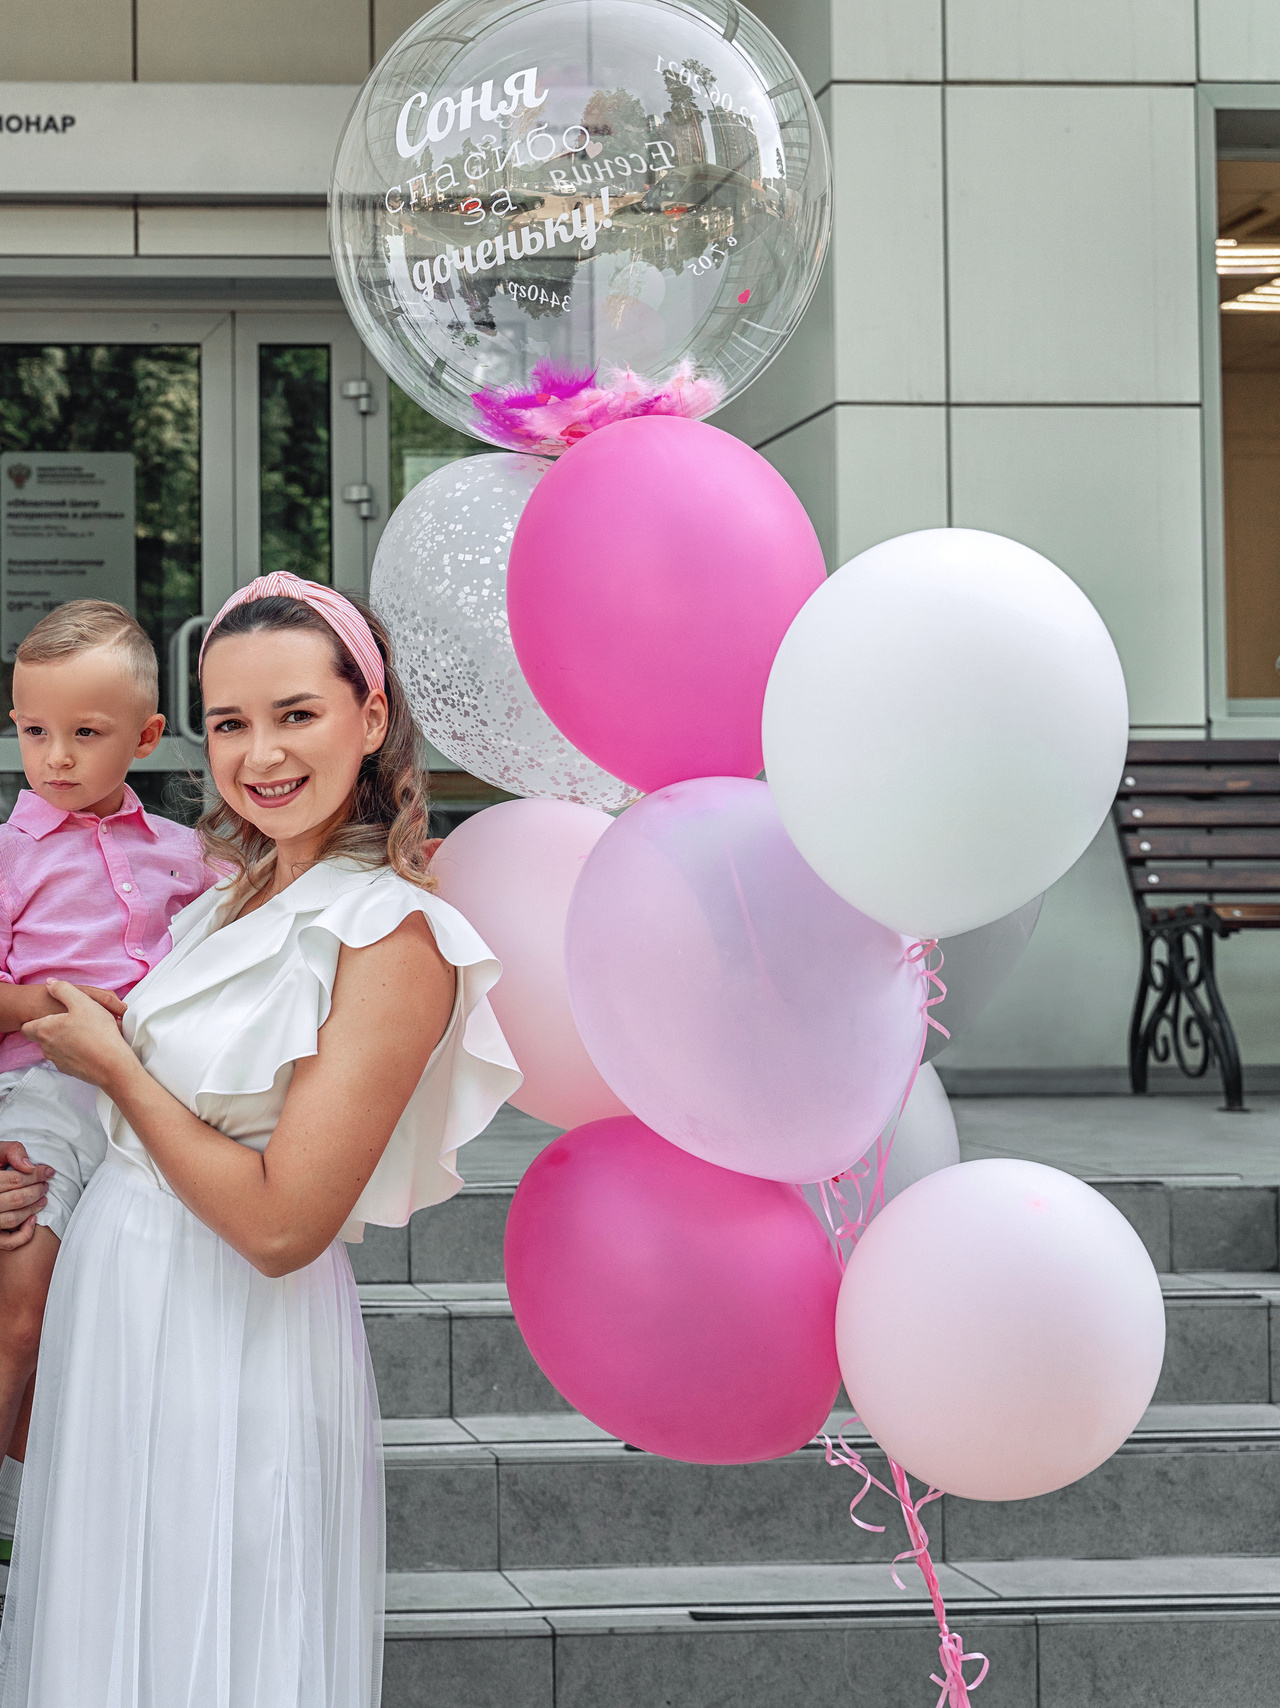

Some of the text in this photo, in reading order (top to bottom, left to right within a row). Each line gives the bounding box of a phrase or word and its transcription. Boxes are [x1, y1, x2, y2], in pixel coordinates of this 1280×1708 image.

[396, 67, 549, 159] Соня
[385, 123, 590, 214] спасибо
[460, 188, 517, 226] за
[413, 186, 613, 302] доченьку!
